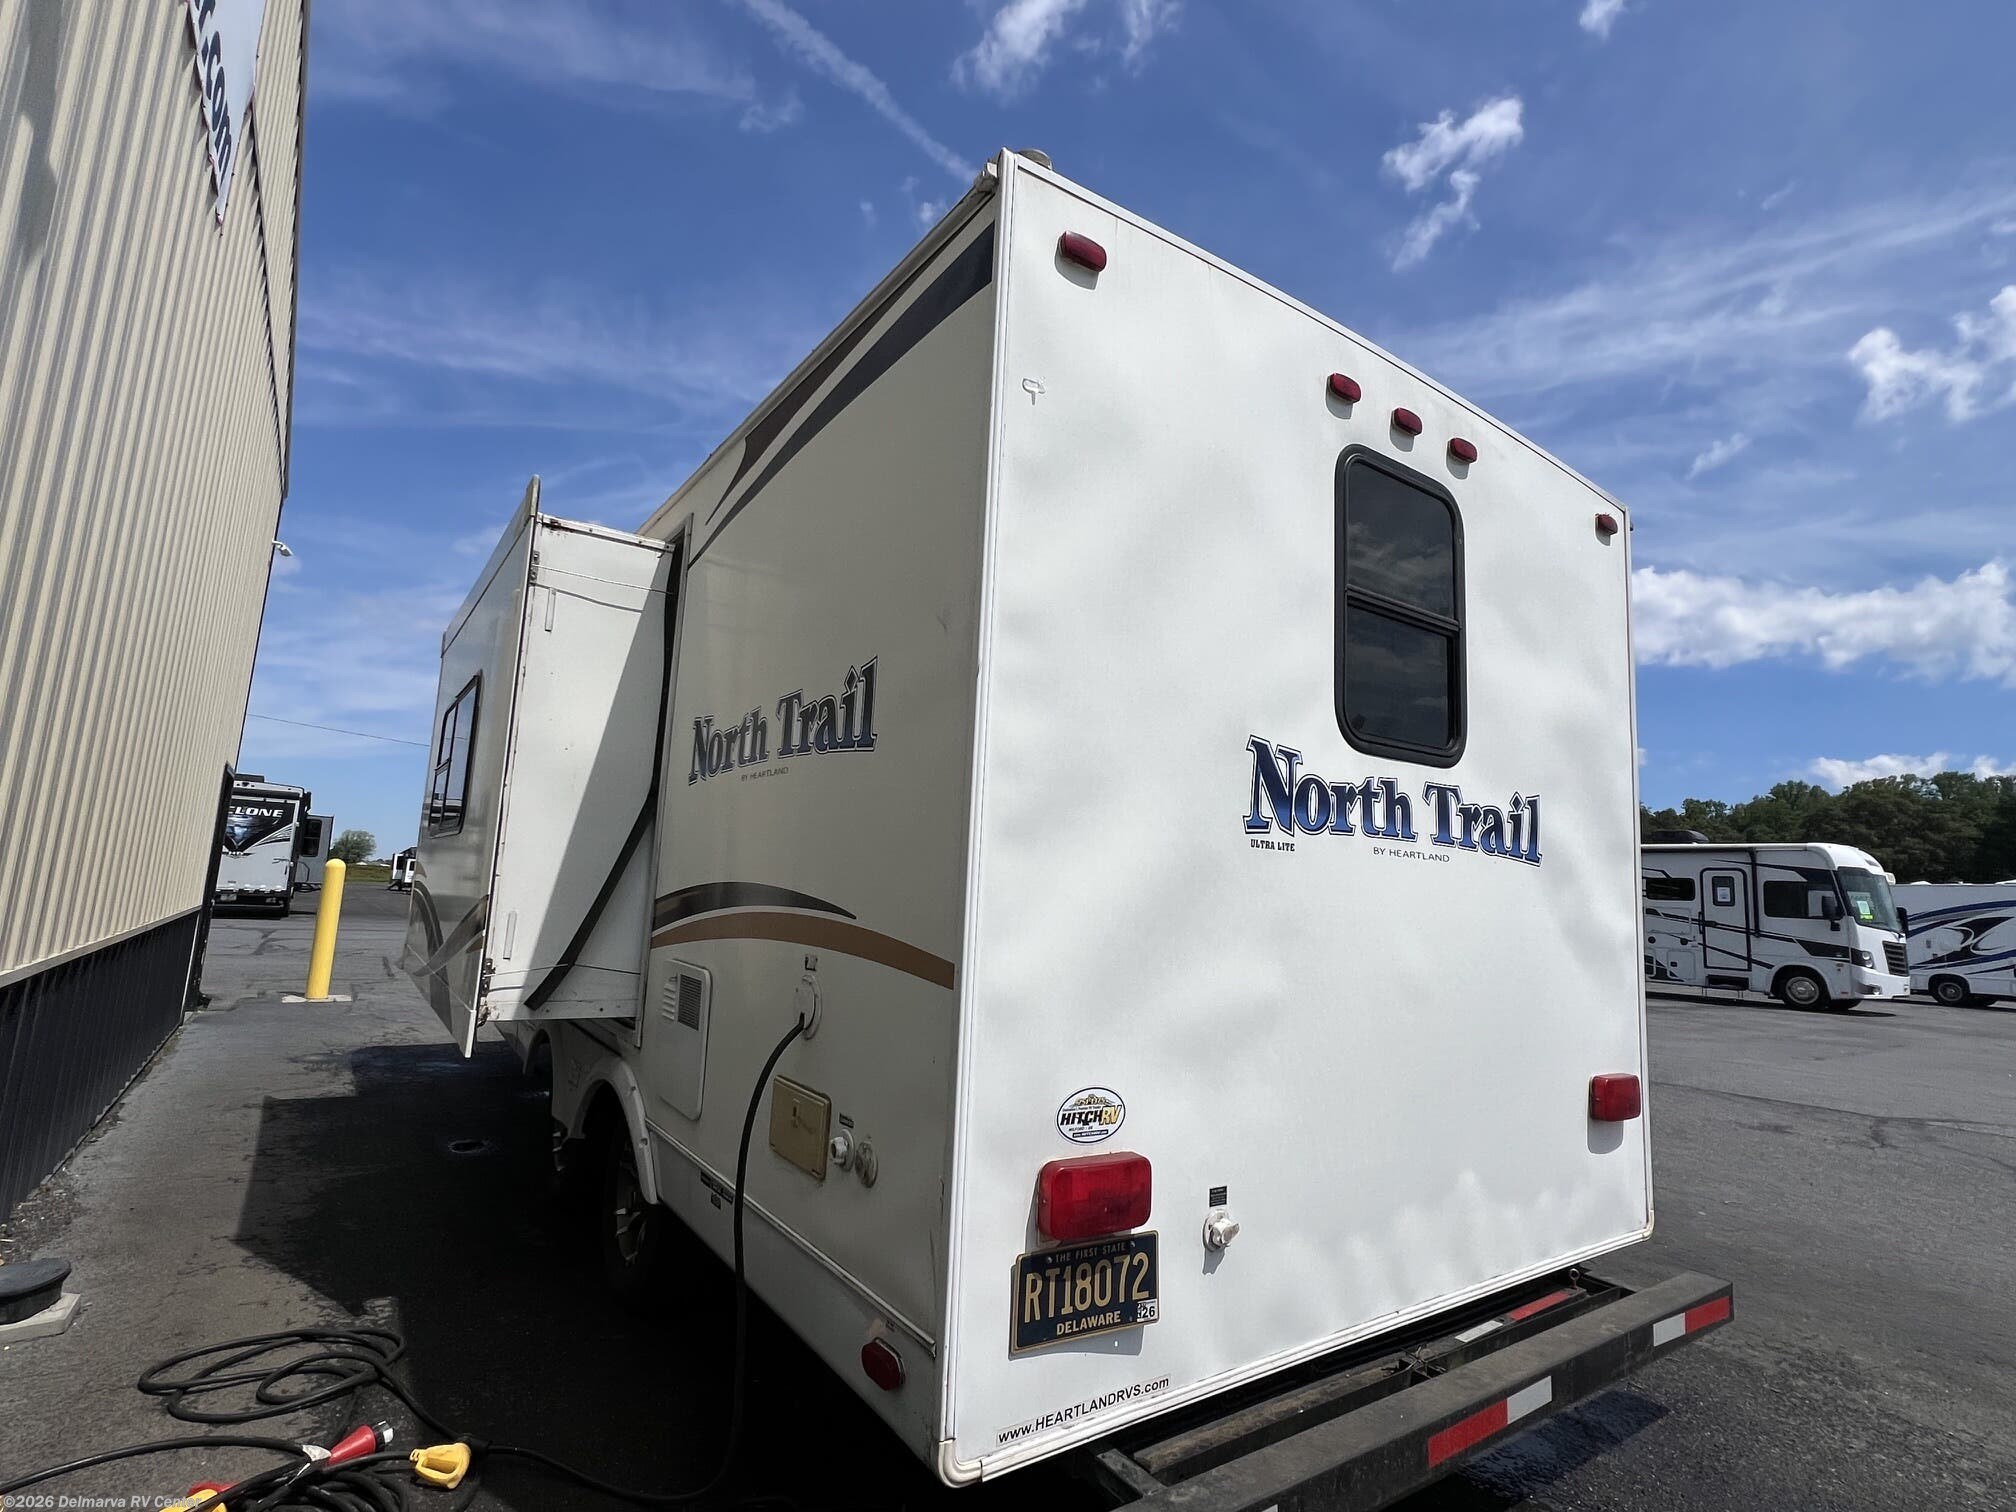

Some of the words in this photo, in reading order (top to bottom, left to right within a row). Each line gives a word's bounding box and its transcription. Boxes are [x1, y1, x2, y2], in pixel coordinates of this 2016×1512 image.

[688, 705, 769, 786] North
[776, 654, 878, 759] Trail
[750, 766, 789, 779] HEARTLAND
[1242, 734, 1418, 842] North
[1422, 780, 1543, 868] Trail
[1250, 838, 1275, 850] ULTRA
[1277, 841, 1295, 852] LITE
[1373, 846, 1386, 855] BY
[1389, 848, 1450, 863] HEARTLAND
[1056, 1251, 1071, 1263] THE
[1075, 1247, 1098, 1260] FIRST
[1102, 1241, 1126, 1255] STATE
[1024, 1251, 1150, 1324] RT18072
[1056, 1310, 1121, 1336] DELAWARE
[998, 1377, 1169, 1443] www.HEARTLANDRVS.com
